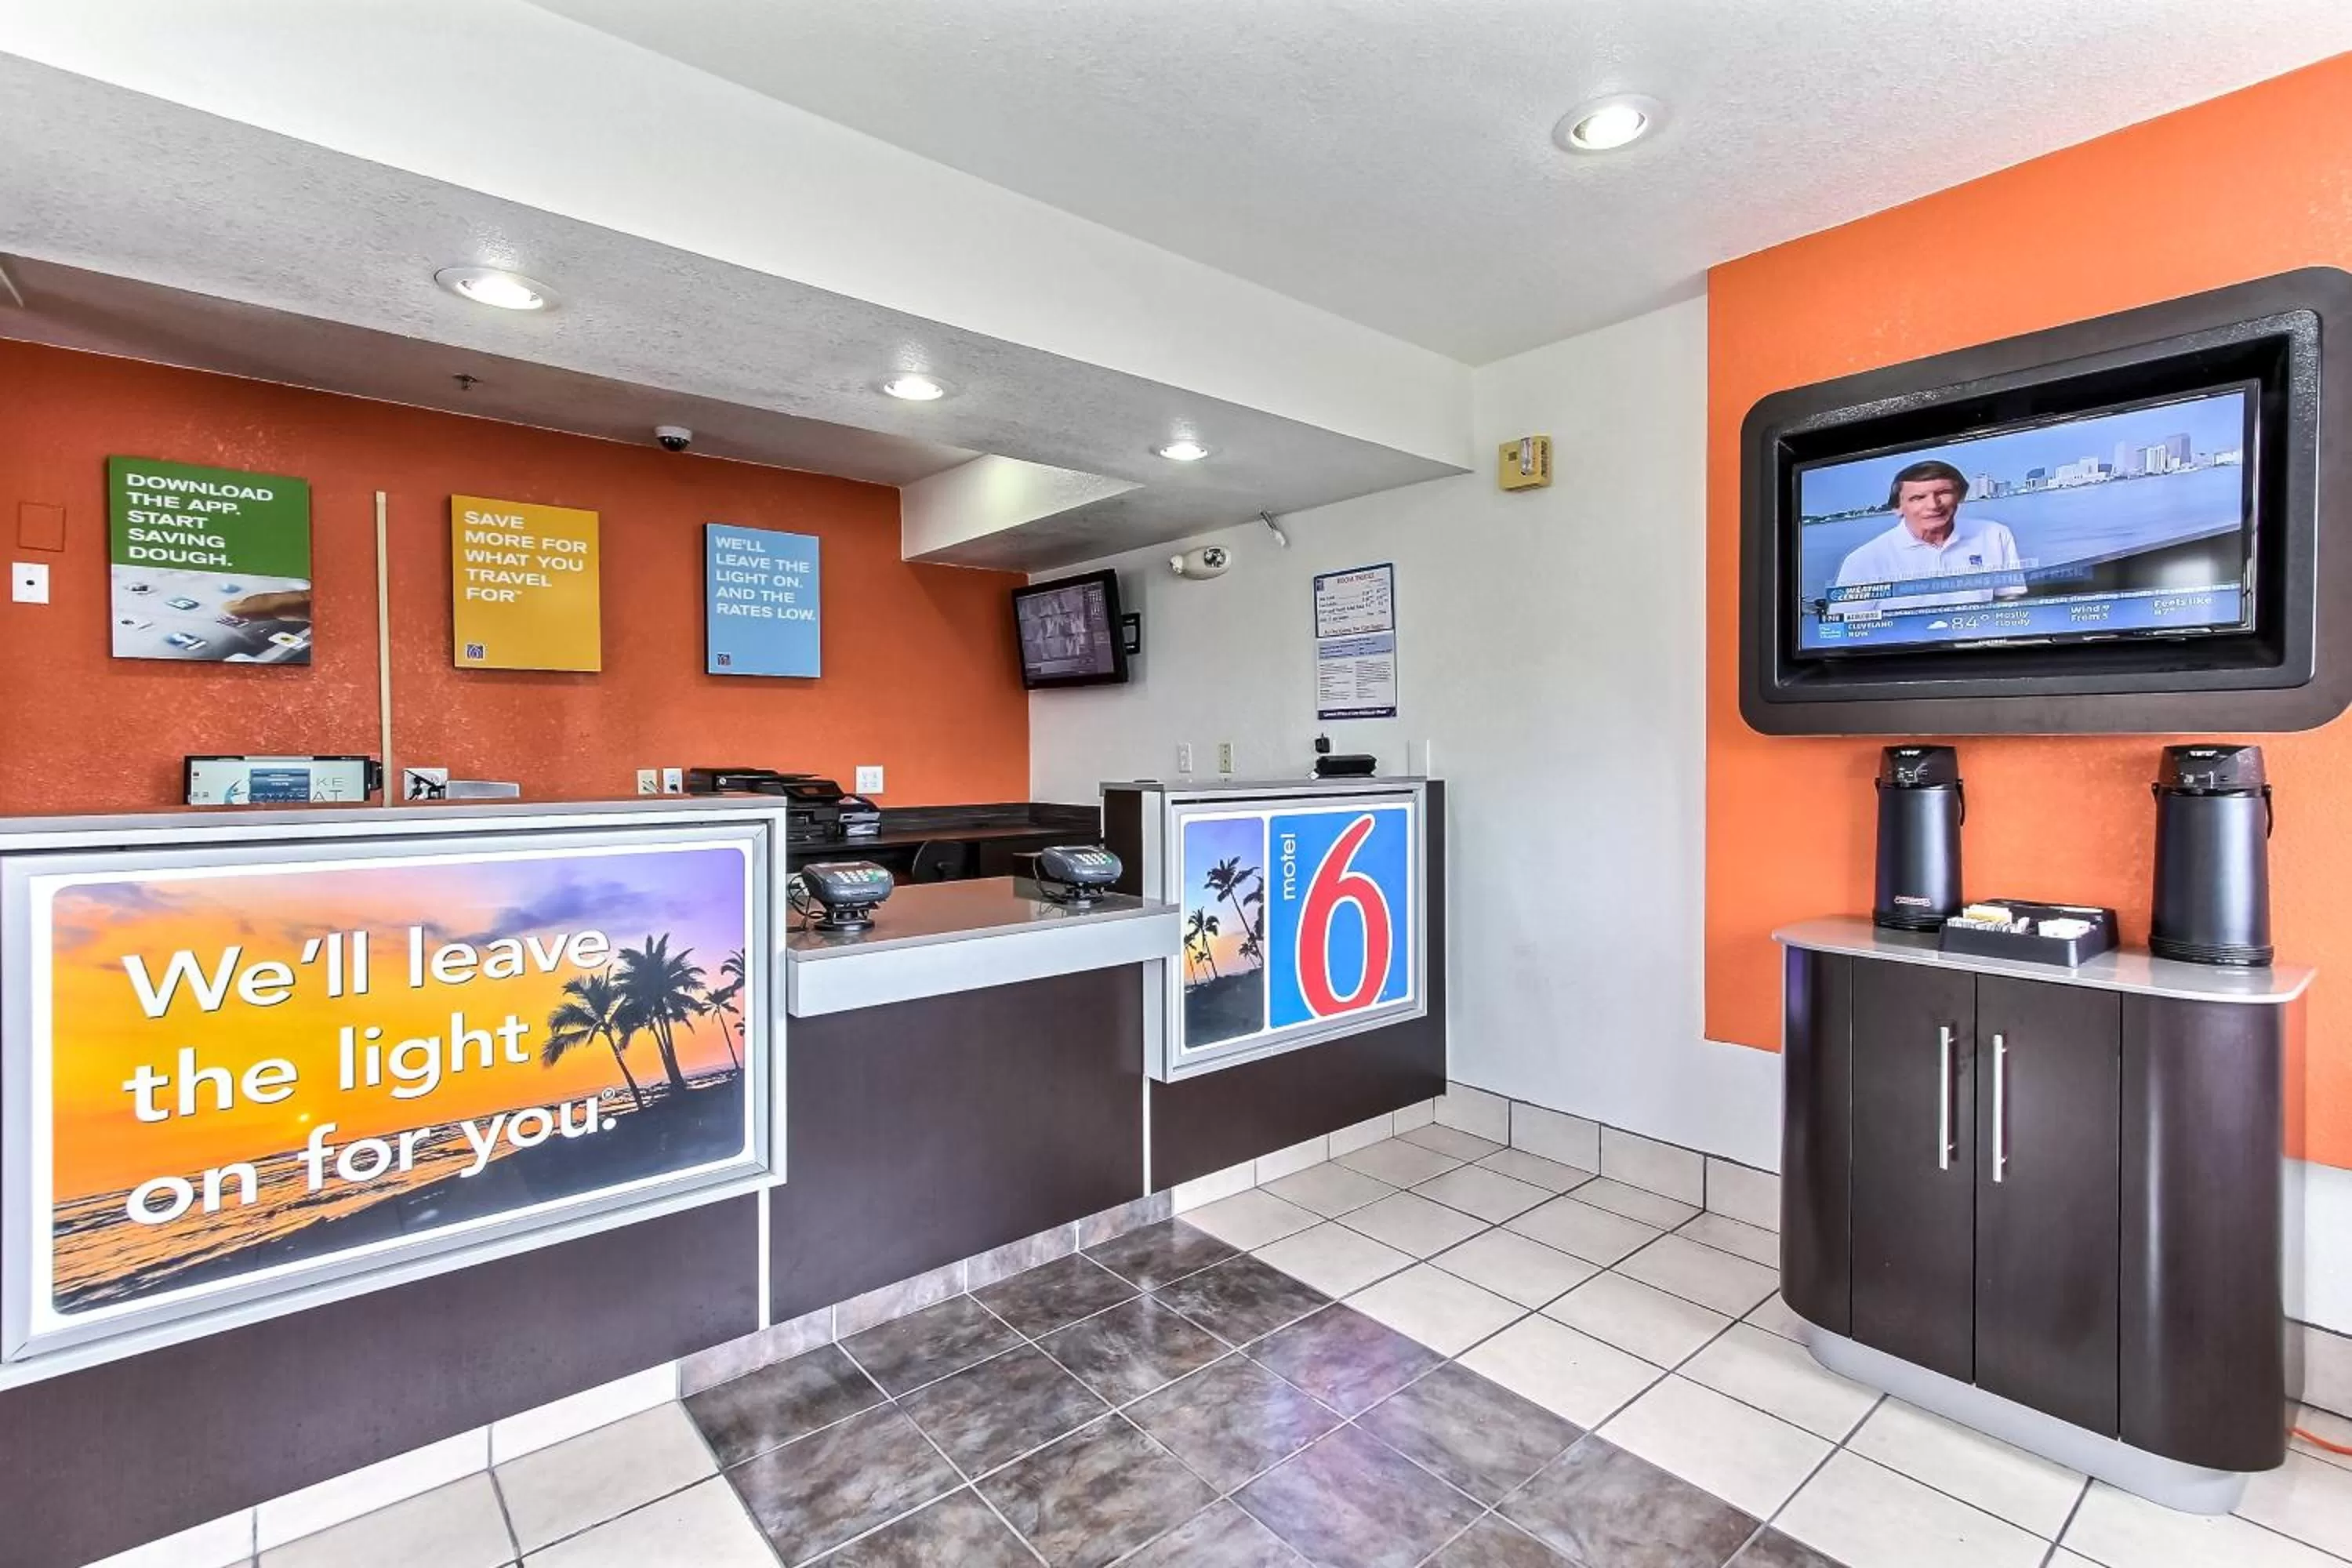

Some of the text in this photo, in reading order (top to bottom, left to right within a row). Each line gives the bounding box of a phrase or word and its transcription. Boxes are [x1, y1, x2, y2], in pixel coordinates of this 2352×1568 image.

[126, 473, 274, 501] DOWNLOAD
[127, 492, 241, 515] THE APP.
[127, 510, 209, 529] START
[464, 510, 524, 529] SAVE
[128, 528, 226, 549] SAVING
[465, 529, 587, 554] MORE FOR
[715, 535, 766, 553] WE'LL
[129, 546, 233, 567] DOUGH.
[465, 549, 583, 572] WHAT YOU
[716, 553, 811, 573] LEAVE THE
[465, 568, 552, 587] TRAVEL
[716, 570, 804, 589] LIGHT ON.
[716, 586, 796, 603] AND THE
[1846, 583, 1892, 593] WEATHER
[717, 603, 816, 620] RATES LOW.
[2071, 606, 2100, 615] Wind
[2154, 598, 2187, 608] Feels
[1995, 610, 2030, 620] Mostly
[2071, 614, 2100, 622] From
[1848, 620, 1893, 630] CLEVELAND
[1279, 833, 1297, 901] motel
[1295, 814, 1393, 1018] 6
[122, 924, 612, 1018] We'll leave
[122, 1012, 532, 1124] the light
[125, 1160, 259, 1227] on
[298, 1123, 432, 1191] for
